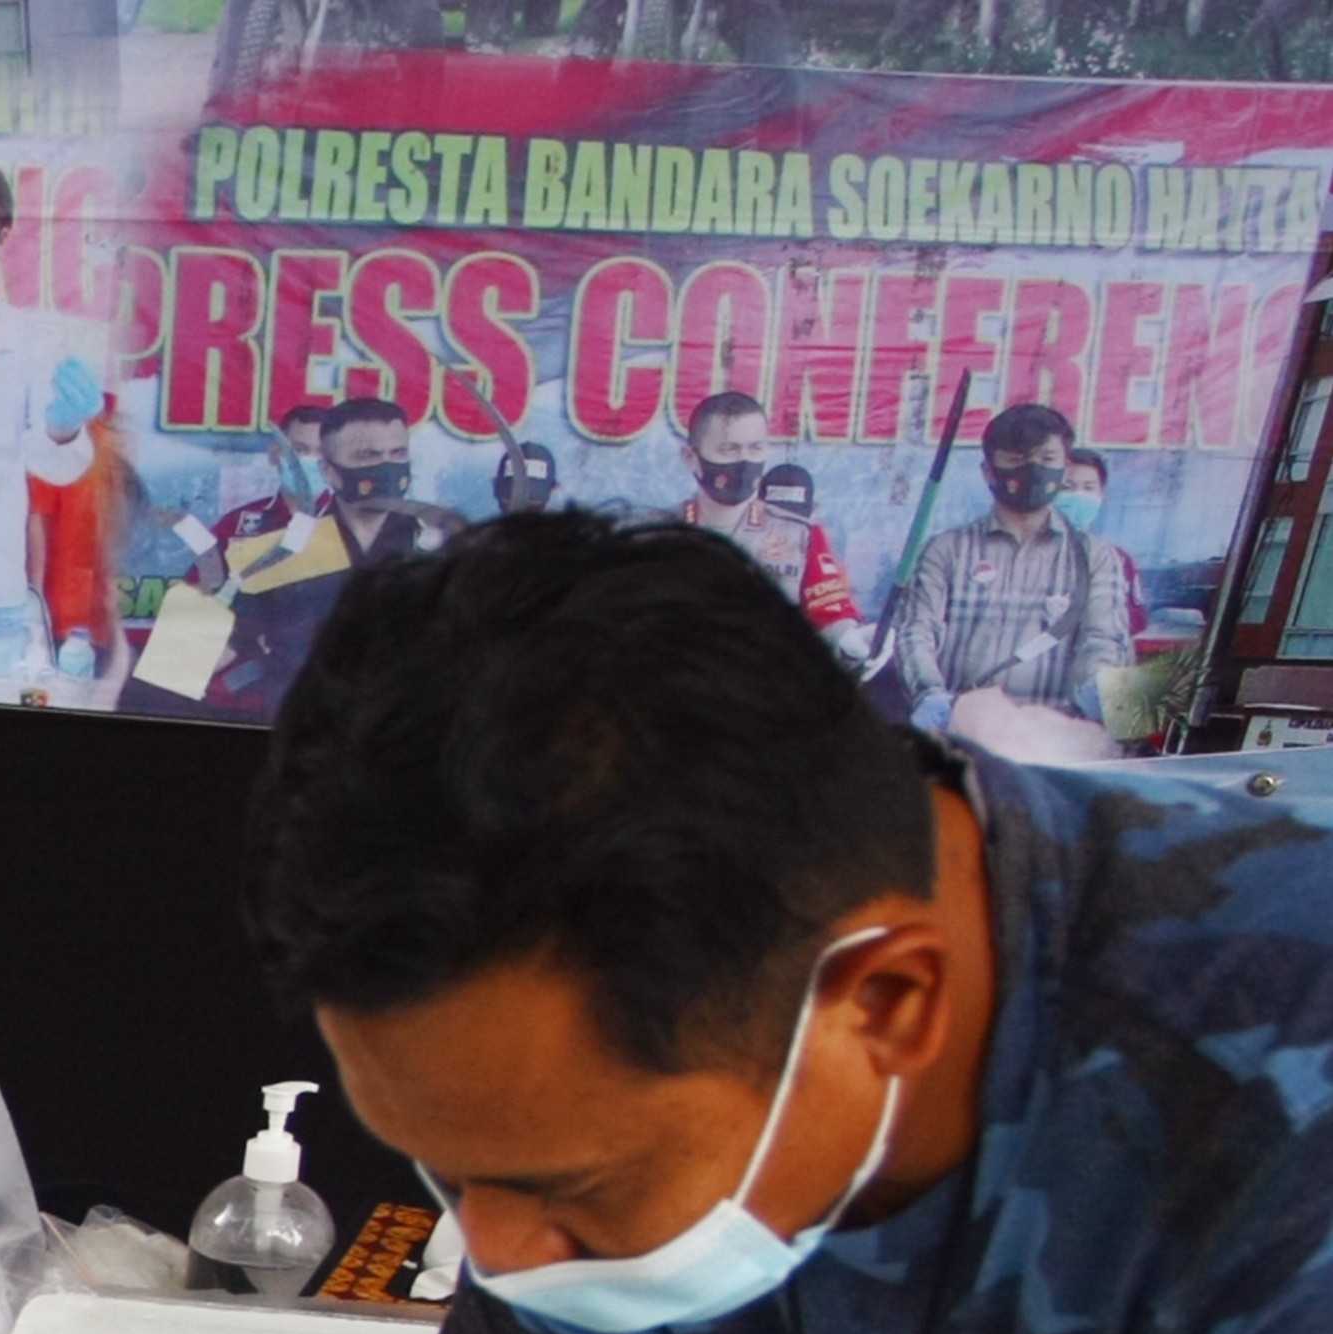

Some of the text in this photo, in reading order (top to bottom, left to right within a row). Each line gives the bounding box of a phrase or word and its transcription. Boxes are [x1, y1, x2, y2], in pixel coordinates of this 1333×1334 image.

[191, 125, 1321, 254] POLRESTA BANDARA SOEKARNO HATTA
